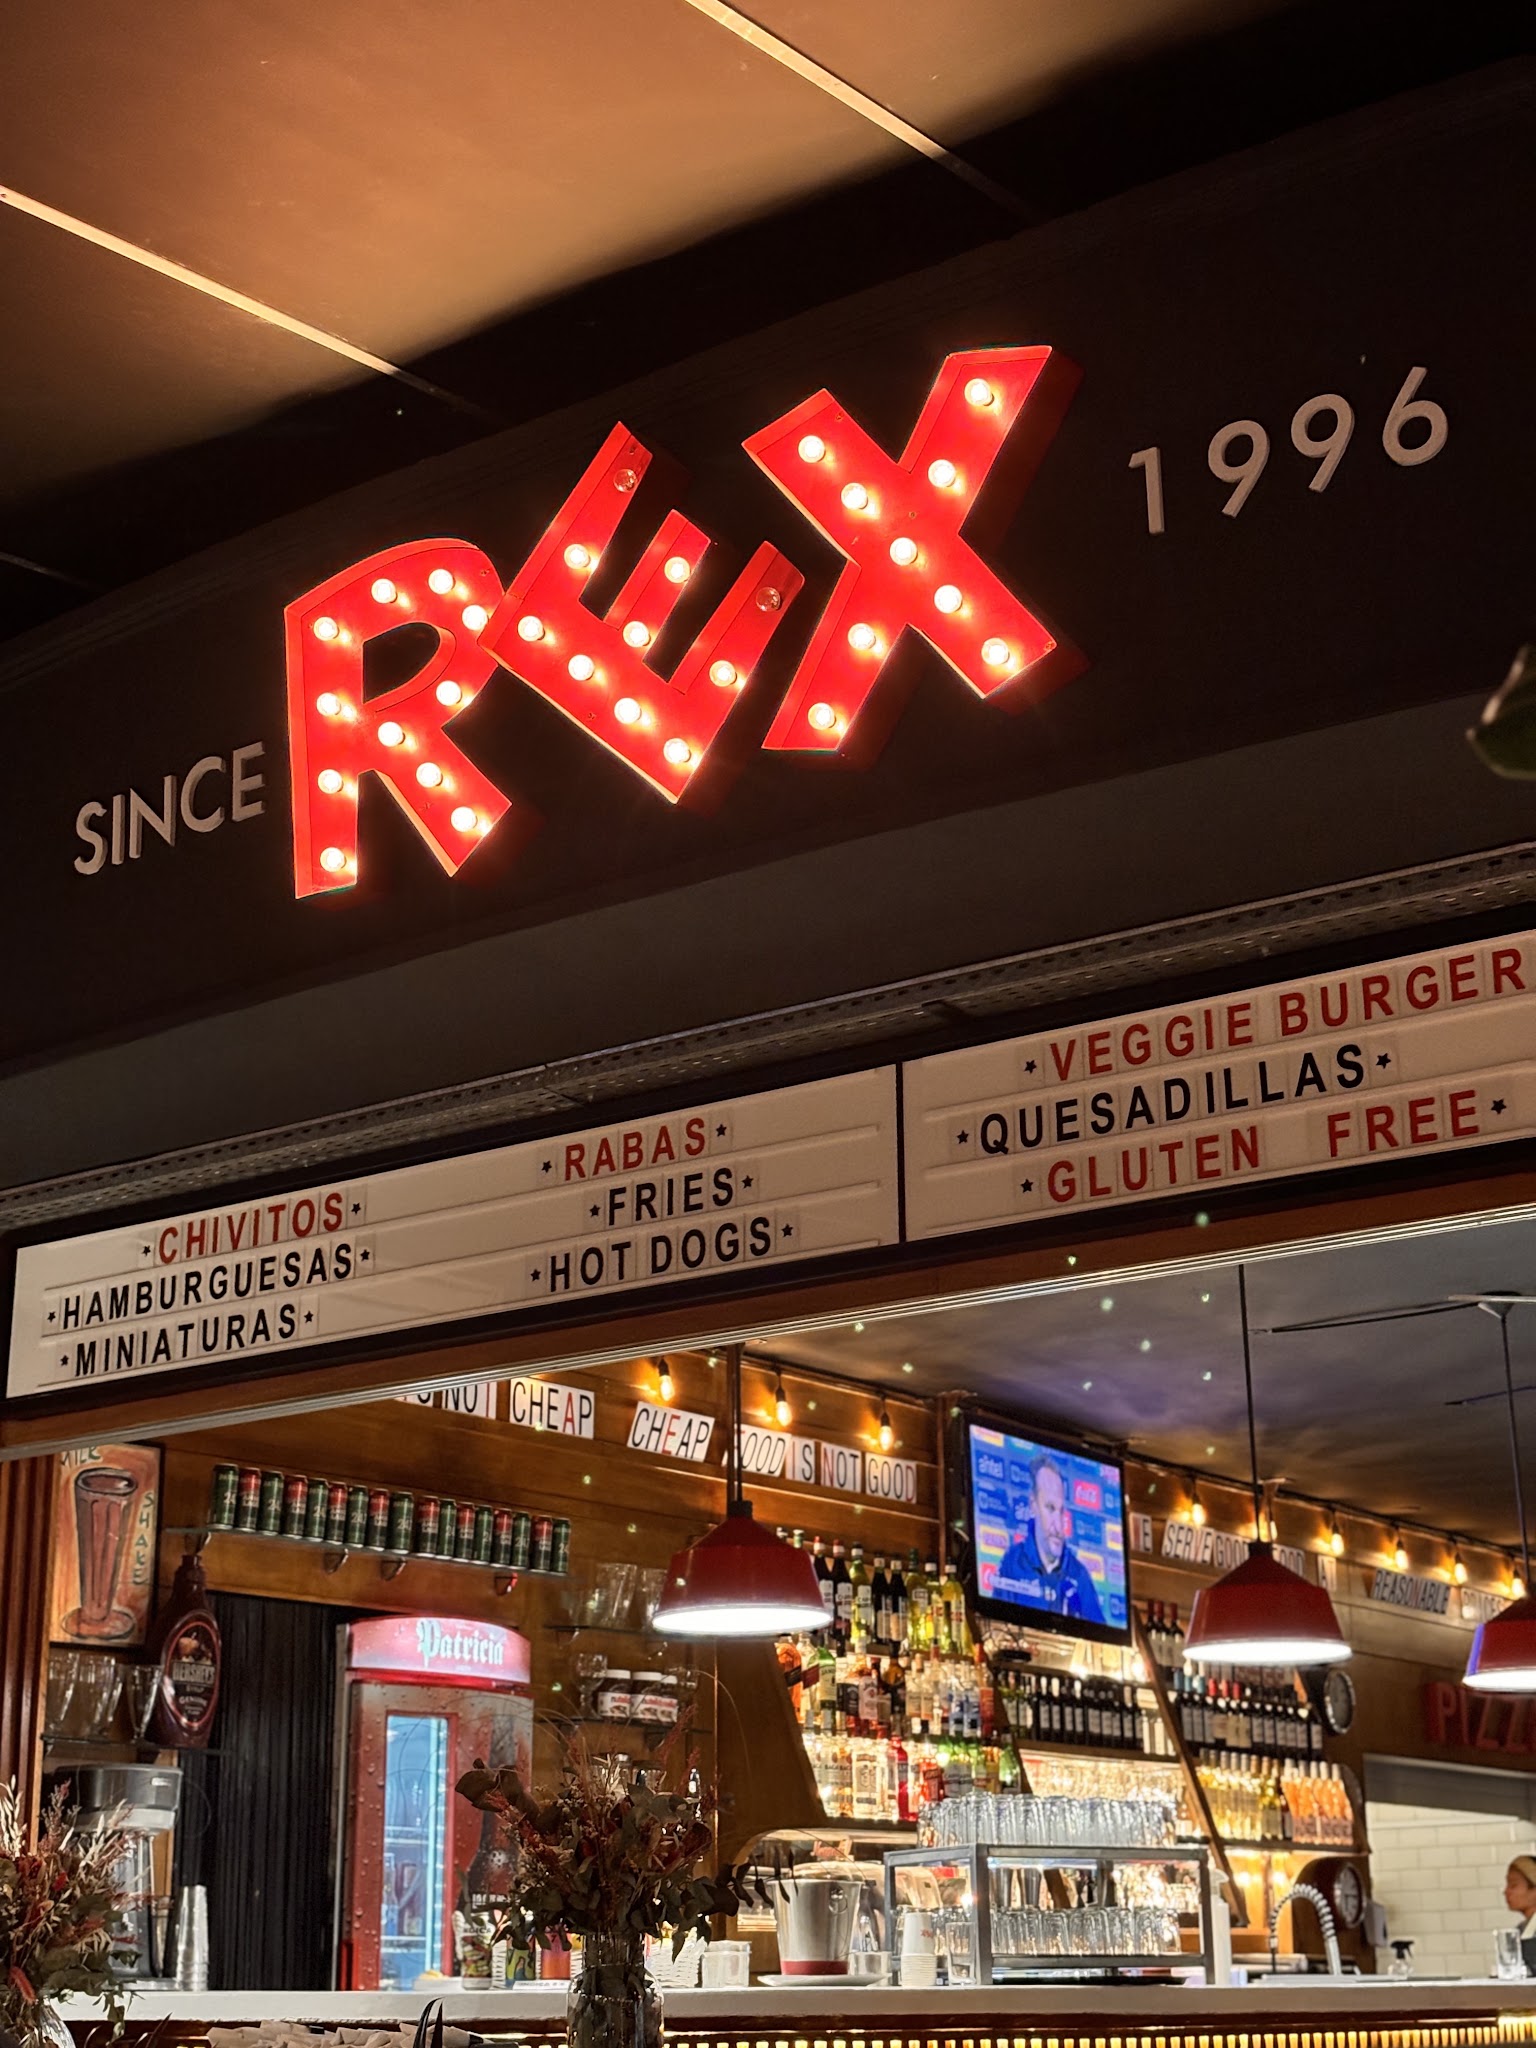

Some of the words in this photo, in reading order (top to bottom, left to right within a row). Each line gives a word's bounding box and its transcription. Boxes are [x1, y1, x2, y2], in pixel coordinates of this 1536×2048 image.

[72, 742, 266, 877] SINCE
[284, 345, 1057, 898] REX
[1128, 366, 1448, 534] 1996
[1050, 1003, 1252, 1081] VEGGIE
[1279, 948, 1526, 1037] BURGER
[980, 1043, 1365, 1154] QUESADILLAS
[564, 1117, 708, 1182] RABAS
[1047, 1126, 1260, 1202] GLUTEN
[1327, 1089, 1480, 1158] FREE
[158, 1192, 346, 1265] CHIVITOS
[608, 1167, 734, 1227] FRIES
[62, 1243, 354, 1330] HAMBURGUESAS
[549, 1241, 633, 1293] HOT
[651, 1216, 772, 1276] DOGS
[74, 1304, 297, 1377] MINIATURAS
[512, 1381, 593, 1436] CHEAP
[632, 1408, 710, 1459] CHEAP
[791, 1440, 814, 1482] IS
[823, 1447, 859, 1491] NOT
[867, 1457, 916, 1502] GOOD
[131, 1491, 155, 1585] SHAKE
[1165, 1524, 1213, 1564] SERVE
[1373, 1569, 1451, 1615] REASONABLE
[416, 1619, 504, 1668] Patricia
